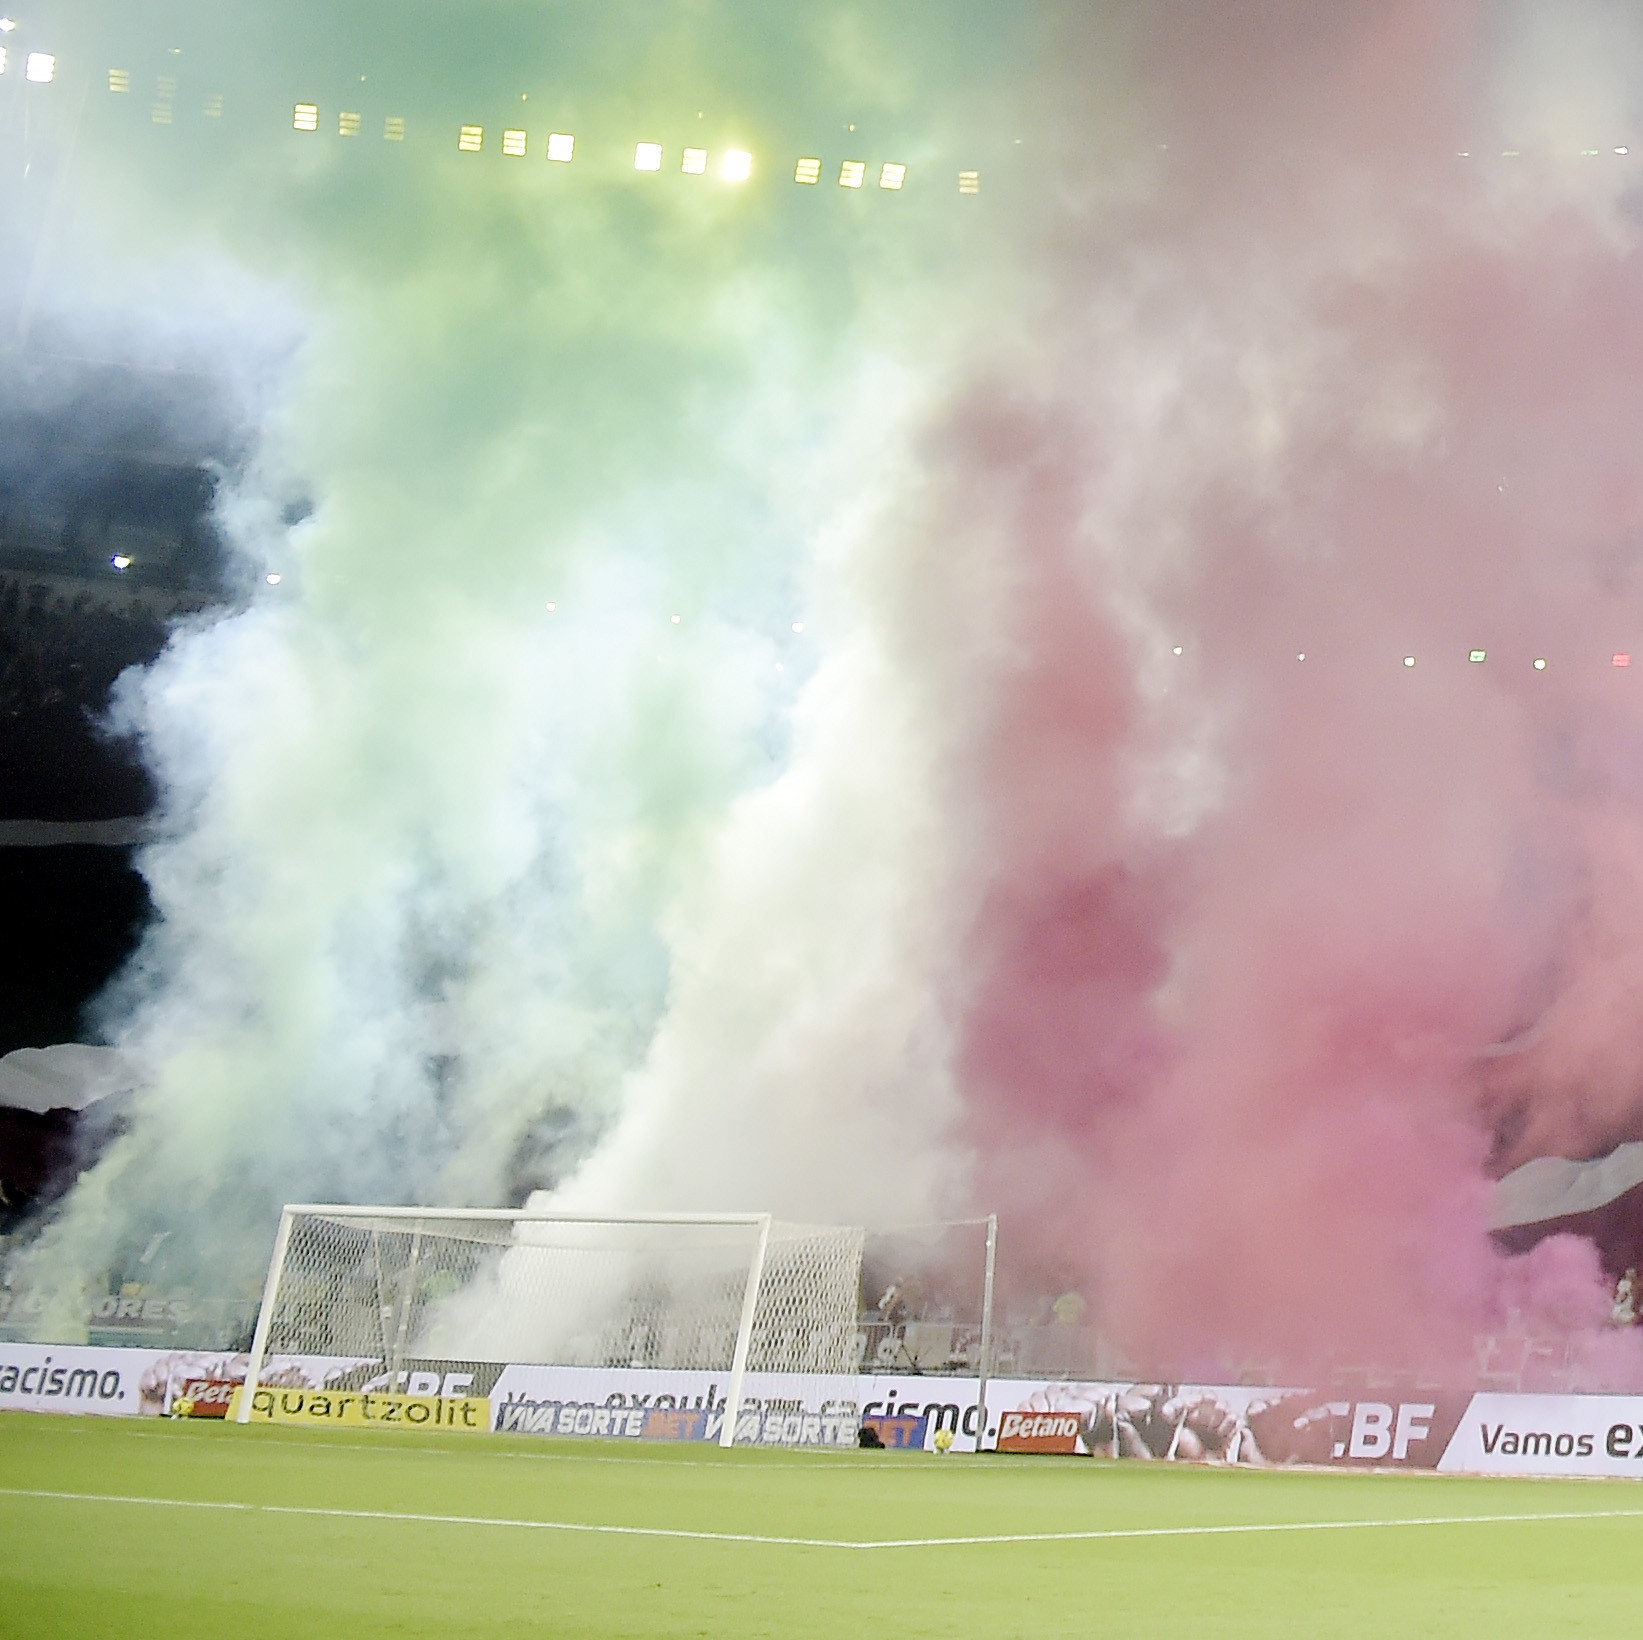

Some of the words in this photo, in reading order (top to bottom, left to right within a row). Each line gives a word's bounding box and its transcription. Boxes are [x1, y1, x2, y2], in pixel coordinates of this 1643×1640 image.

[0, 1356, 125, 1401] acismo.
[252, 1391, 477, 1427] quartzolit
[502, 1405, 554, 1433] VIVA
[557, 1407, 644, 1437] SORTE
[1002, 1414, 1078, 1438] Betano
[1481, 1424, 1594, 1457] Vamos
